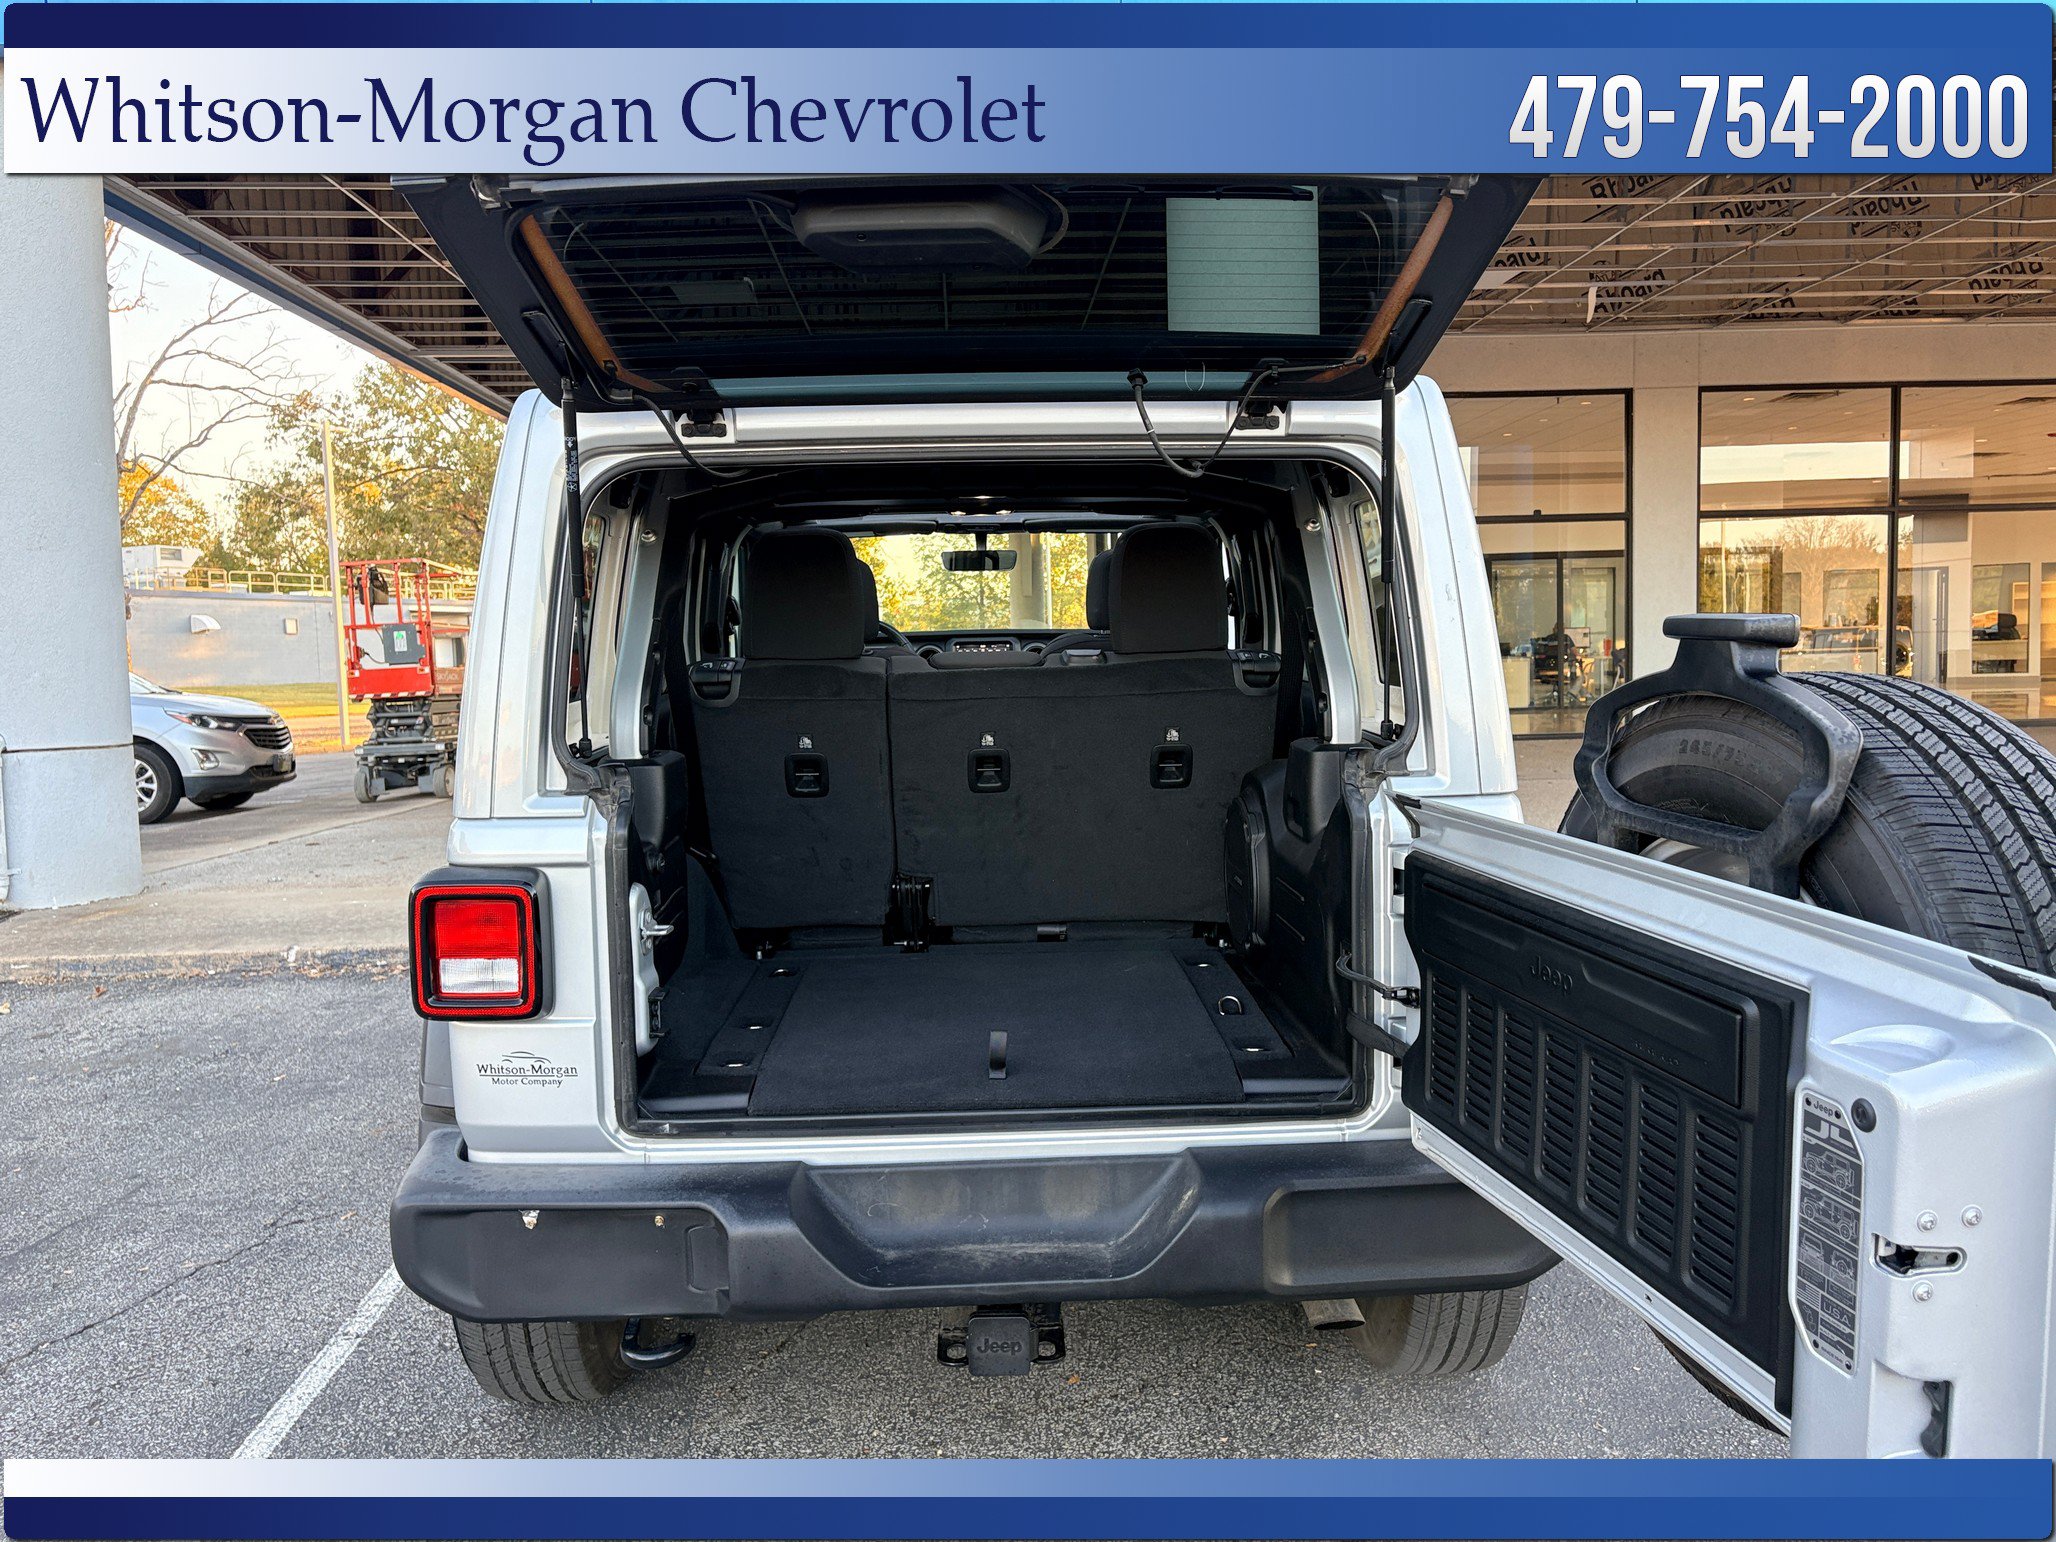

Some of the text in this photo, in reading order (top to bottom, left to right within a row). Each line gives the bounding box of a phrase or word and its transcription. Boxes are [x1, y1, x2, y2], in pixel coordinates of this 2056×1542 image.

[1531, 955, 1573, 997] Jeep
[476, 1064, 578, 1078] Whitson-Morgan
[492, 1077, 563, 1088] Motor Company
[1813, 1100, 1834, 1117] Jeep
[976, 1338, 1023, 1355] Jeep
